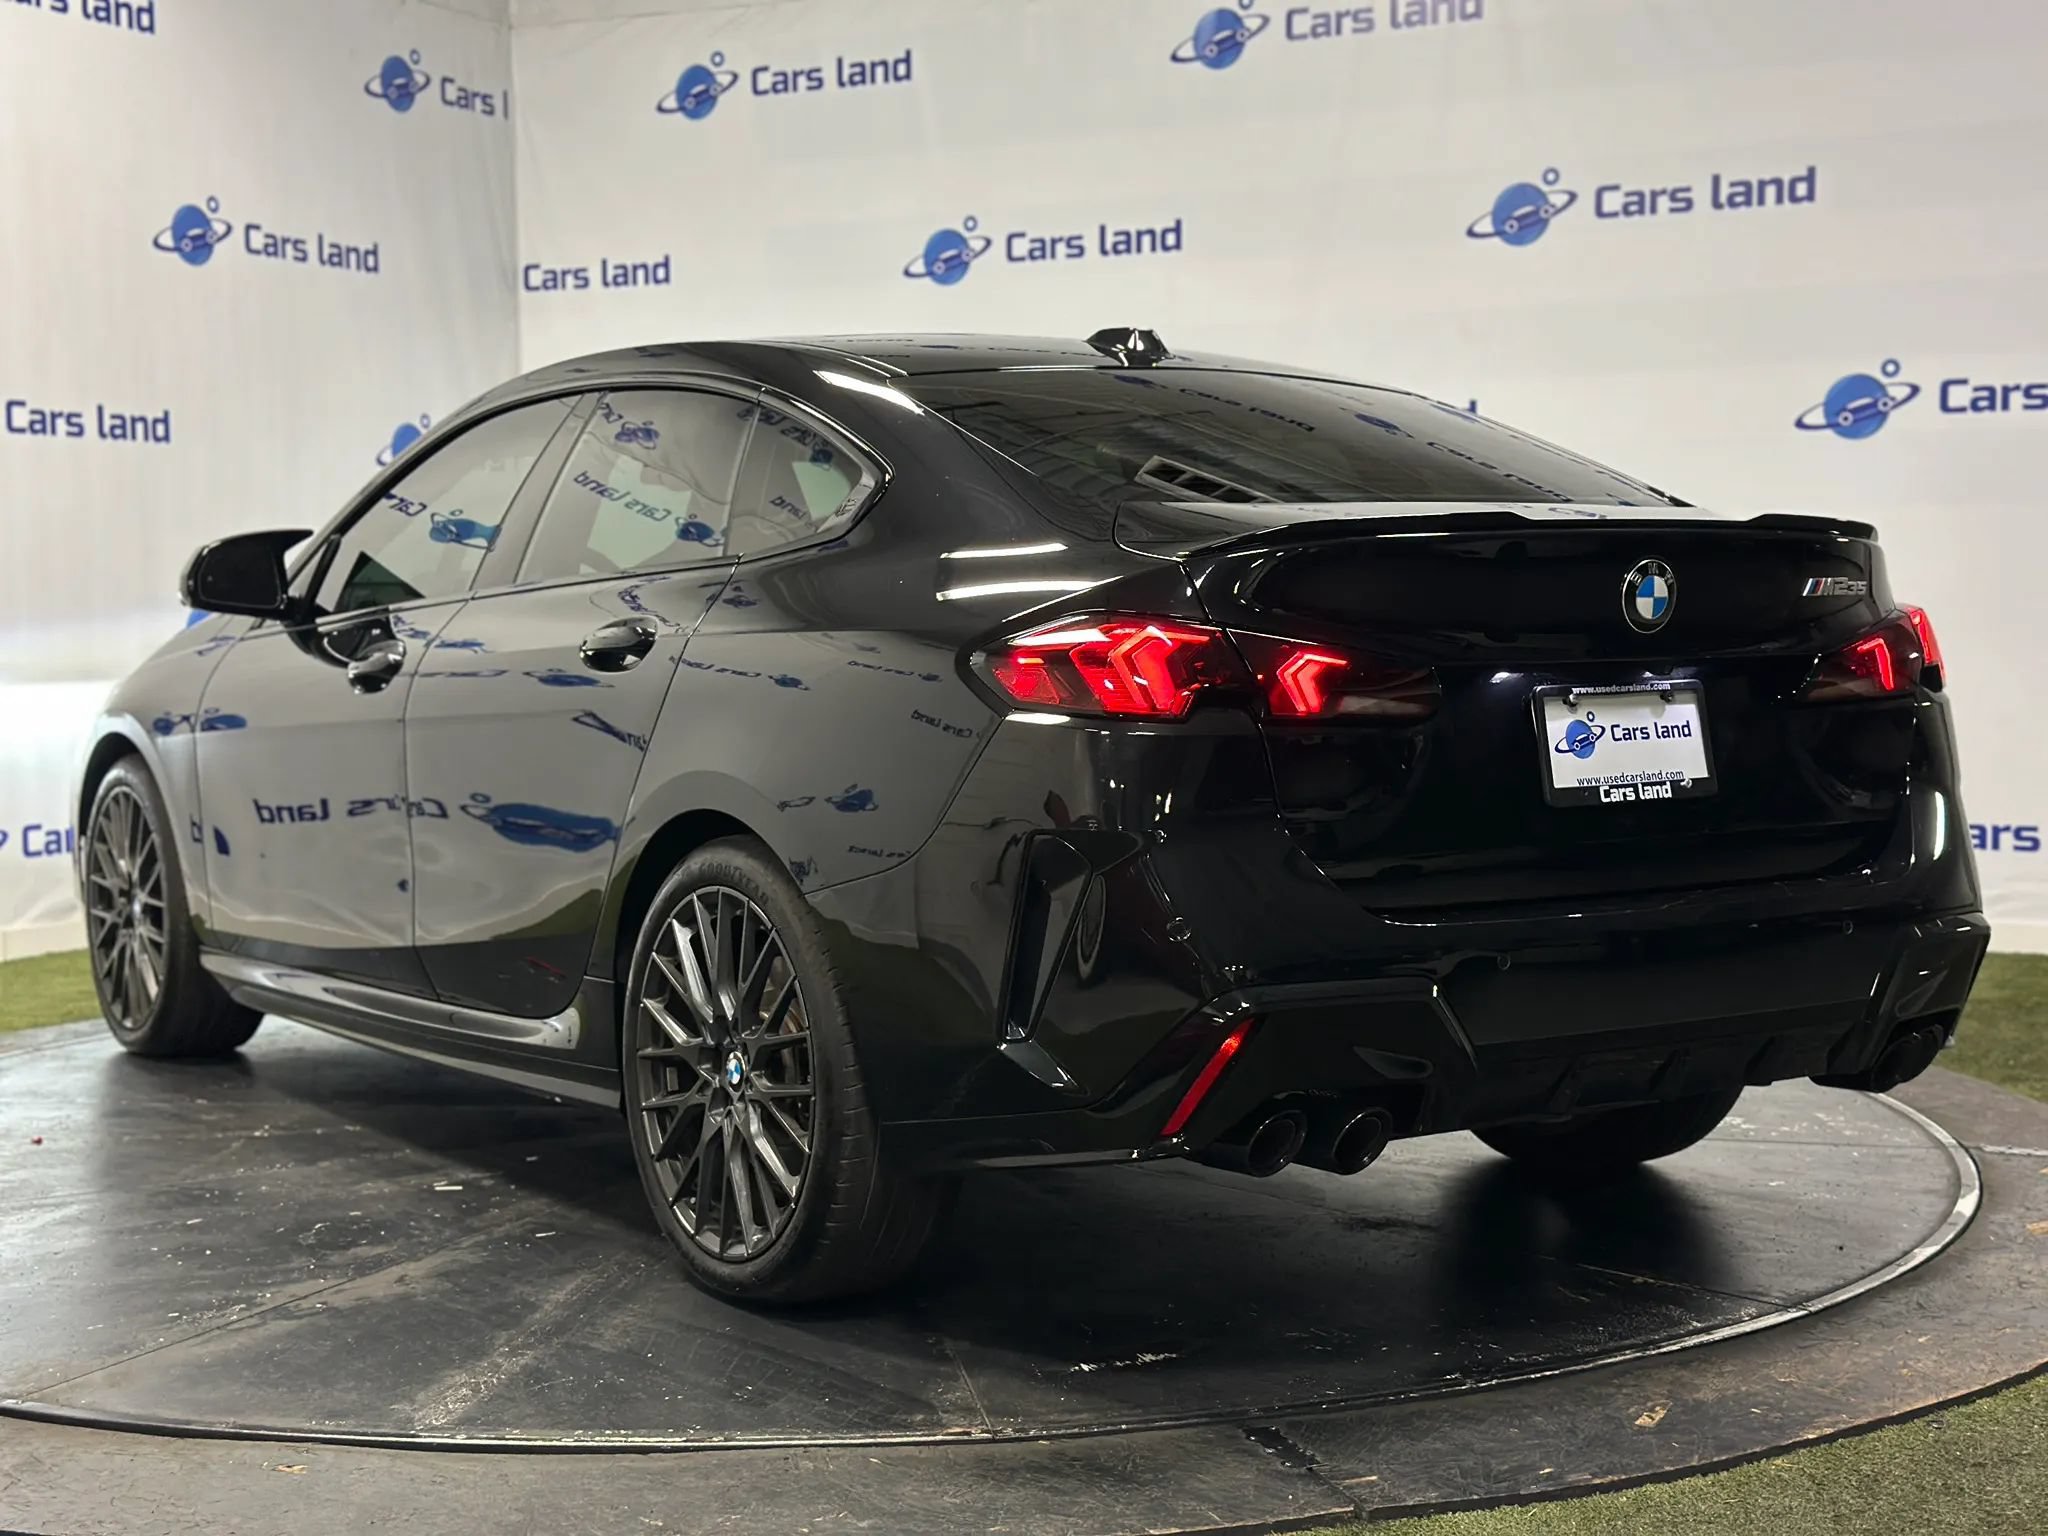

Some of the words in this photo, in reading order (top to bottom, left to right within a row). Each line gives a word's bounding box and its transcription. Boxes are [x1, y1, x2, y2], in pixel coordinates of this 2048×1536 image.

[1285, 7, 1375, 41] Cars
[752, 65, 824, 96] Cars
[837, 49, 912, 89] land
[441, 75, 496, 116] Cars
[1595, 183, 1694, 219] Cars
[1711, 166, 1817, 210] land
[244, 224, 308, 263] Cars
[318, 233, 379, 273] land
[1006, 231, 1085, 263] Cars
[1099, 218, 1183, 257] land
[524, 263, 590, 292] Cars
[602, 255, 671, 288] land
[1940, 378, 2048, 414] Cars
[6, 400, 85, 438] Cars
[97, 404, 171, 443] land
[1571, 683, 1671, 695] www.usedcarsland.com
[1610, 724, 1650, 742] Cars
[1654, 720, 1692, 739] land
[1576, 770, 1685, 786] www.usedcarsland.com
[1599, 786, 1636, 803] Cars
[1637, 781, 1673, 800] land
[22, 824, 74, 857] Car
[1968, 823, 2042, 852] ars
